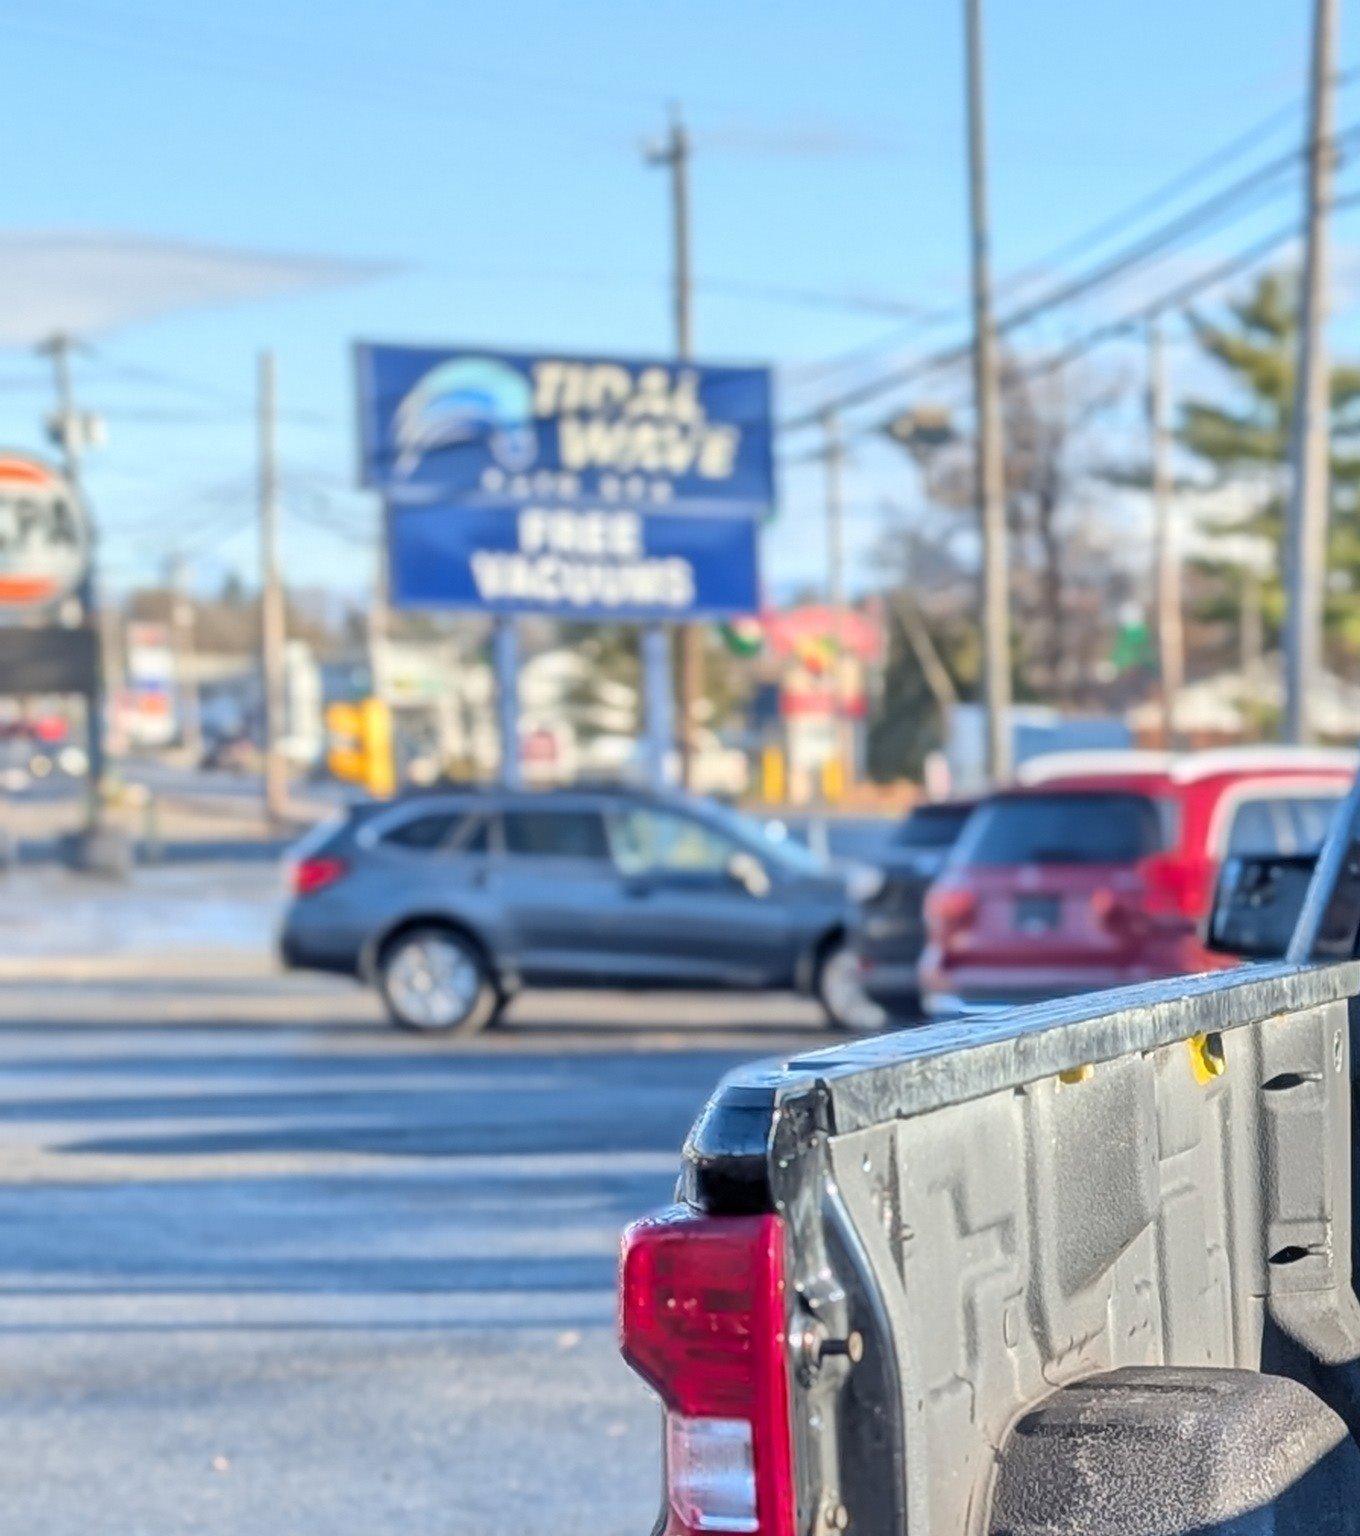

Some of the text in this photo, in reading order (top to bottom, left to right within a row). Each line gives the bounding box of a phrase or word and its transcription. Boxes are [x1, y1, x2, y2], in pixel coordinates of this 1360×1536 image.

[558, 417, 741, 479] WAVE
[517, 506, 644, 558] FREE
[469, 550, 698, 608] VACUUMS
